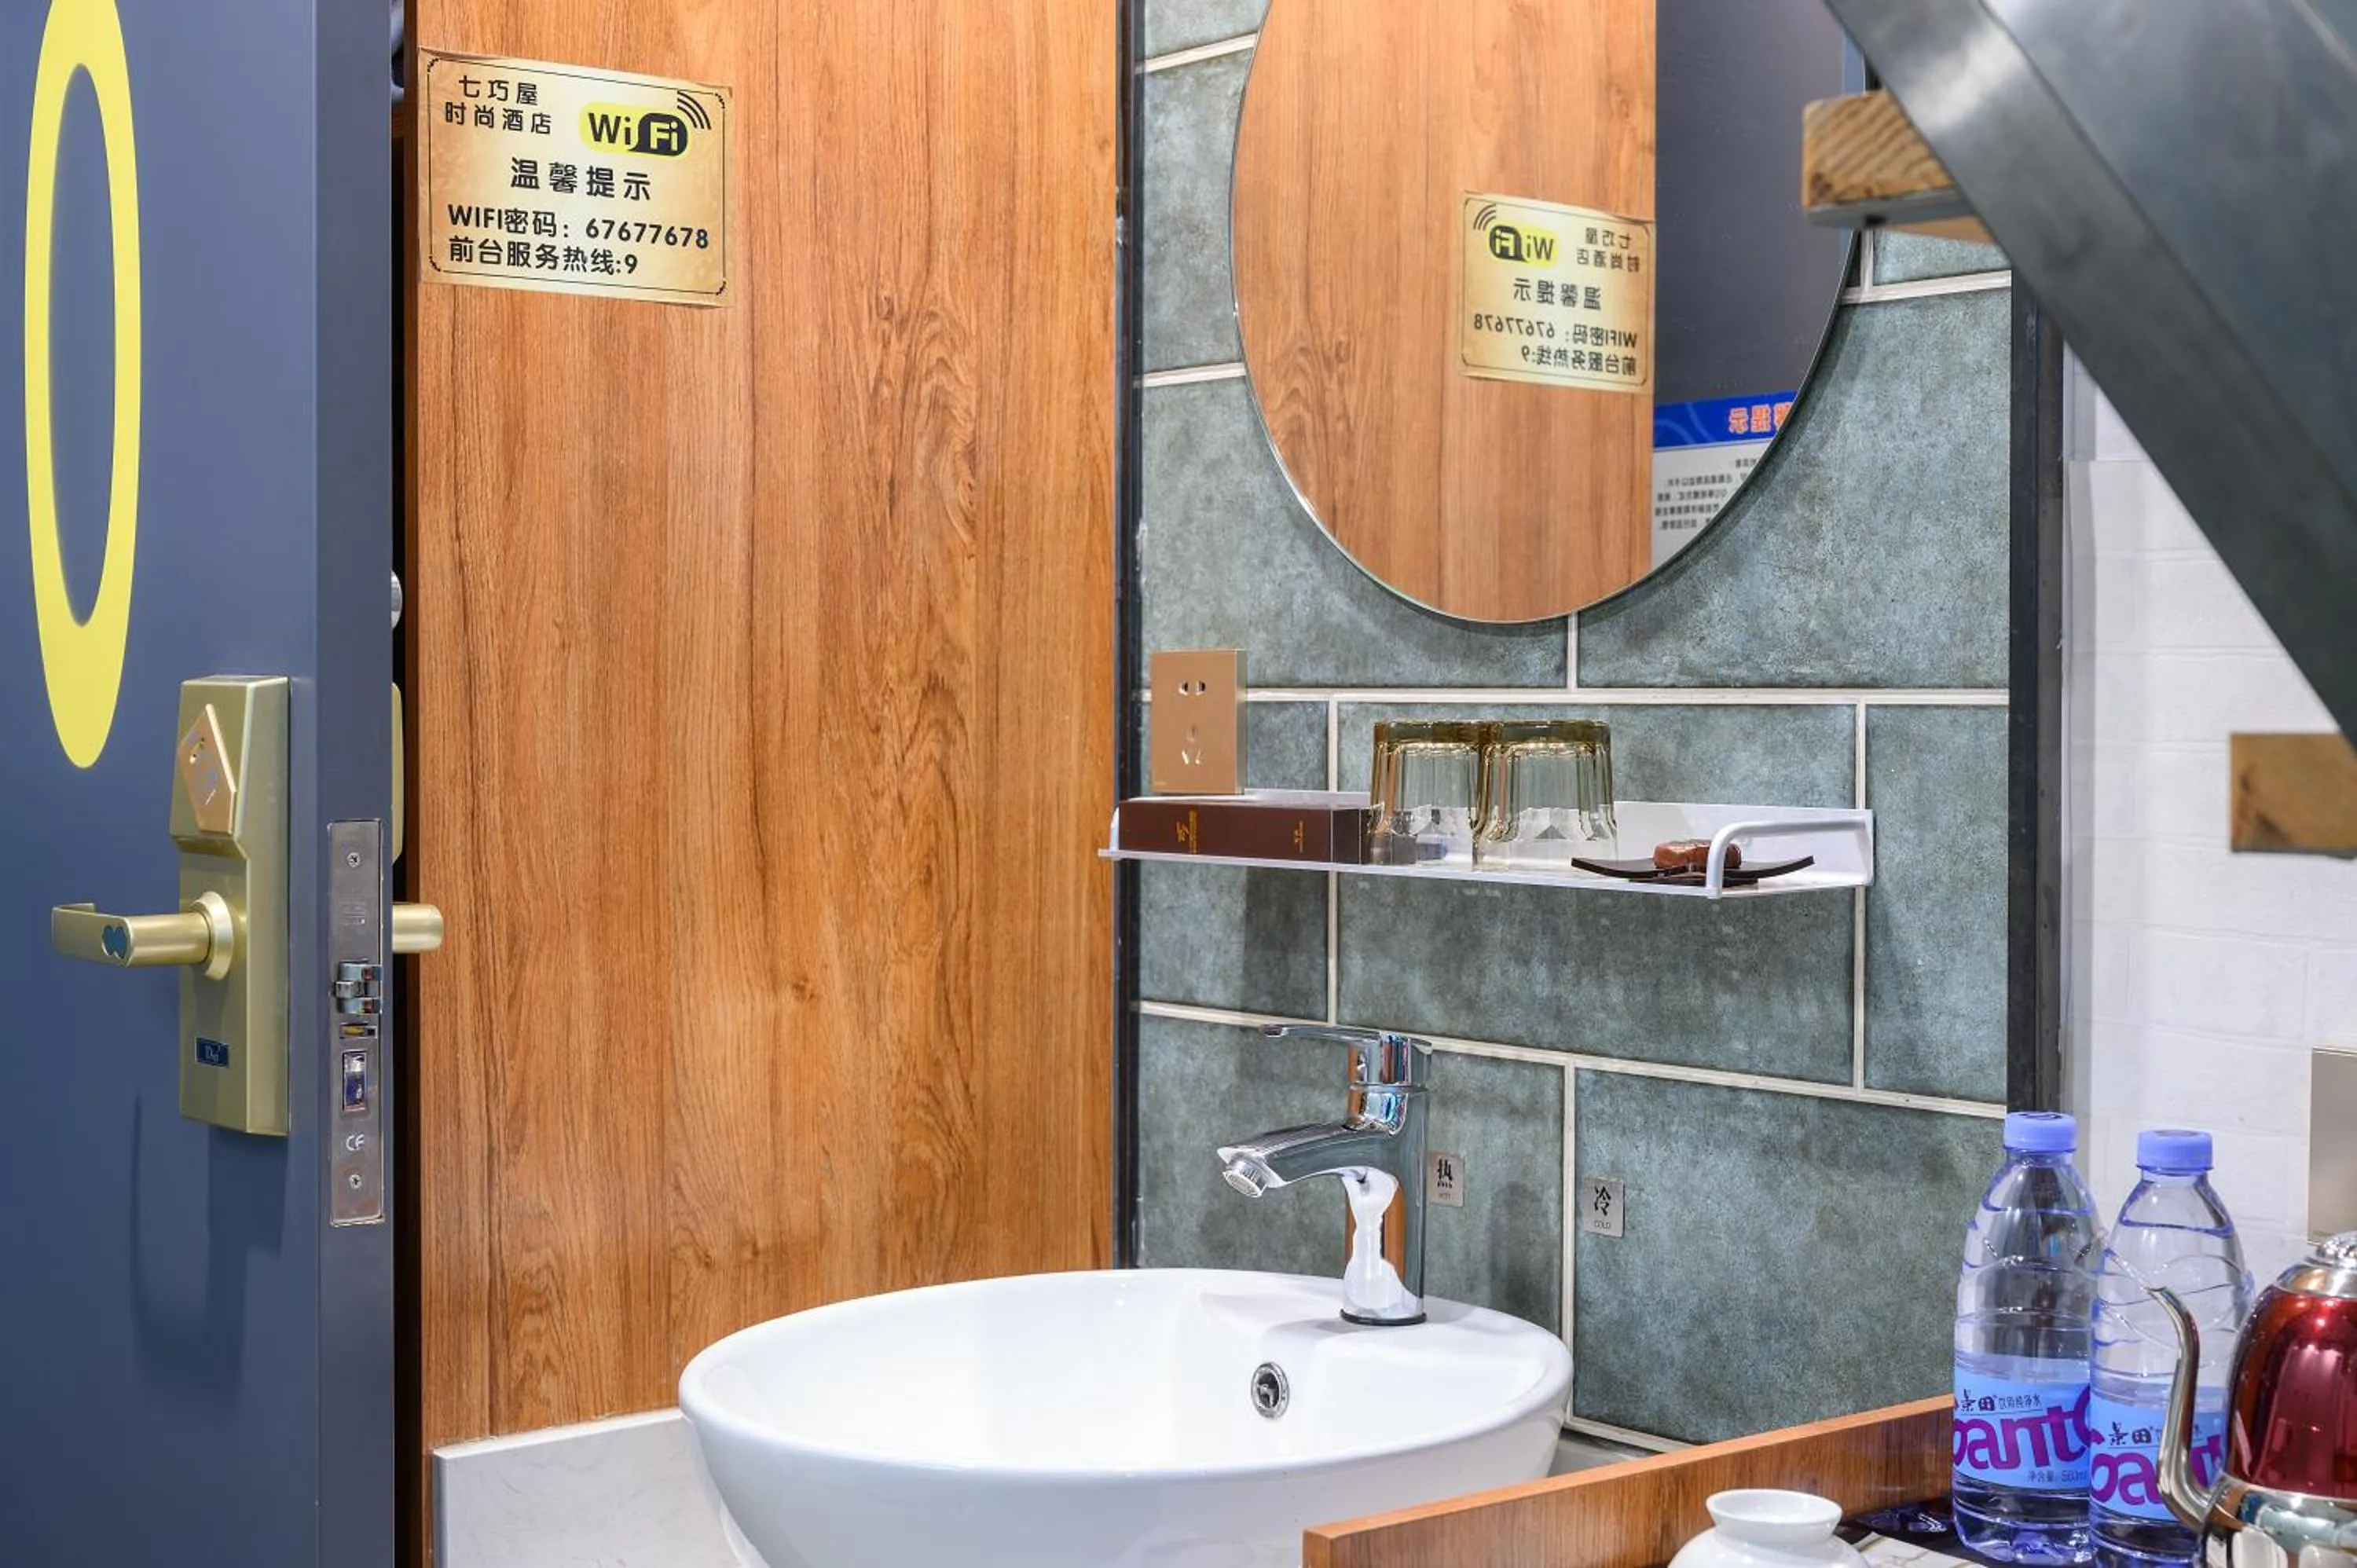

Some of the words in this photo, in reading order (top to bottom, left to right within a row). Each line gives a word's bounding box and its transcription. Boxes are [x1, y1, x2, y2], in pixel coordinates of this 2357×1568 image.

[458, 75, 539, 107] 七巧屋
[445, 101, 552, 135] 时尚酒店
[588, 112, 685, 156] WiFi
[511, 156, 652, 202] 温馨提示
[1437, 1159, 1453, 1189] 热
[1593, 1185, 1611, 1217] 冷
[1961, 1388, 1995, 1412] 景田
[2109, 1421, 2152, 1446] 景田
